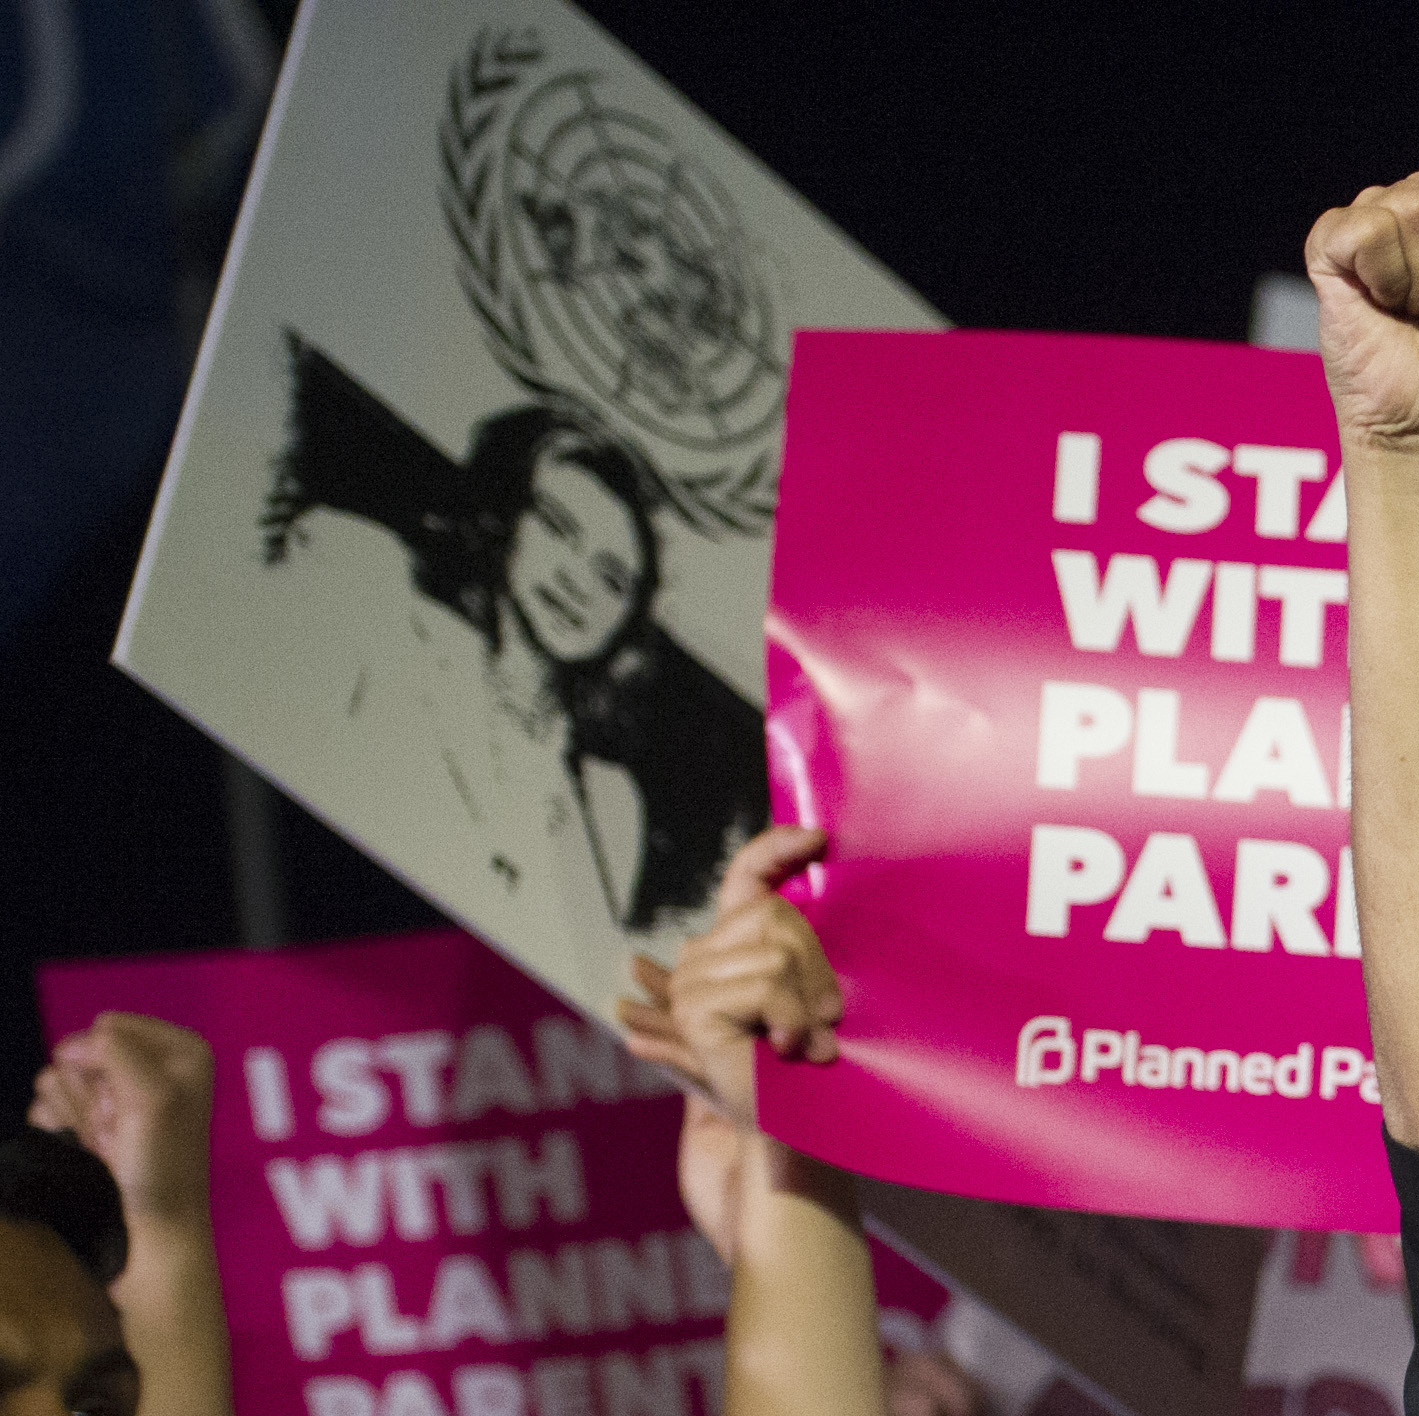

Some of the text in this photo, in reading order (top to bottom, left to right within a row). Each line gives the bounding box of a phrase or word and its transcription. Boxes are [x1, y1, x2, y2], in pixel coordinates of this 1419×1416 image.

[1052, 431, 1101, 525] I
[1051, 547, 1348, 669] WIT
[243, 1044, 297, 1142] I
[1081, 1029, 1314, 1100] Planned
[267, 1131, 589, 1249] WITH
